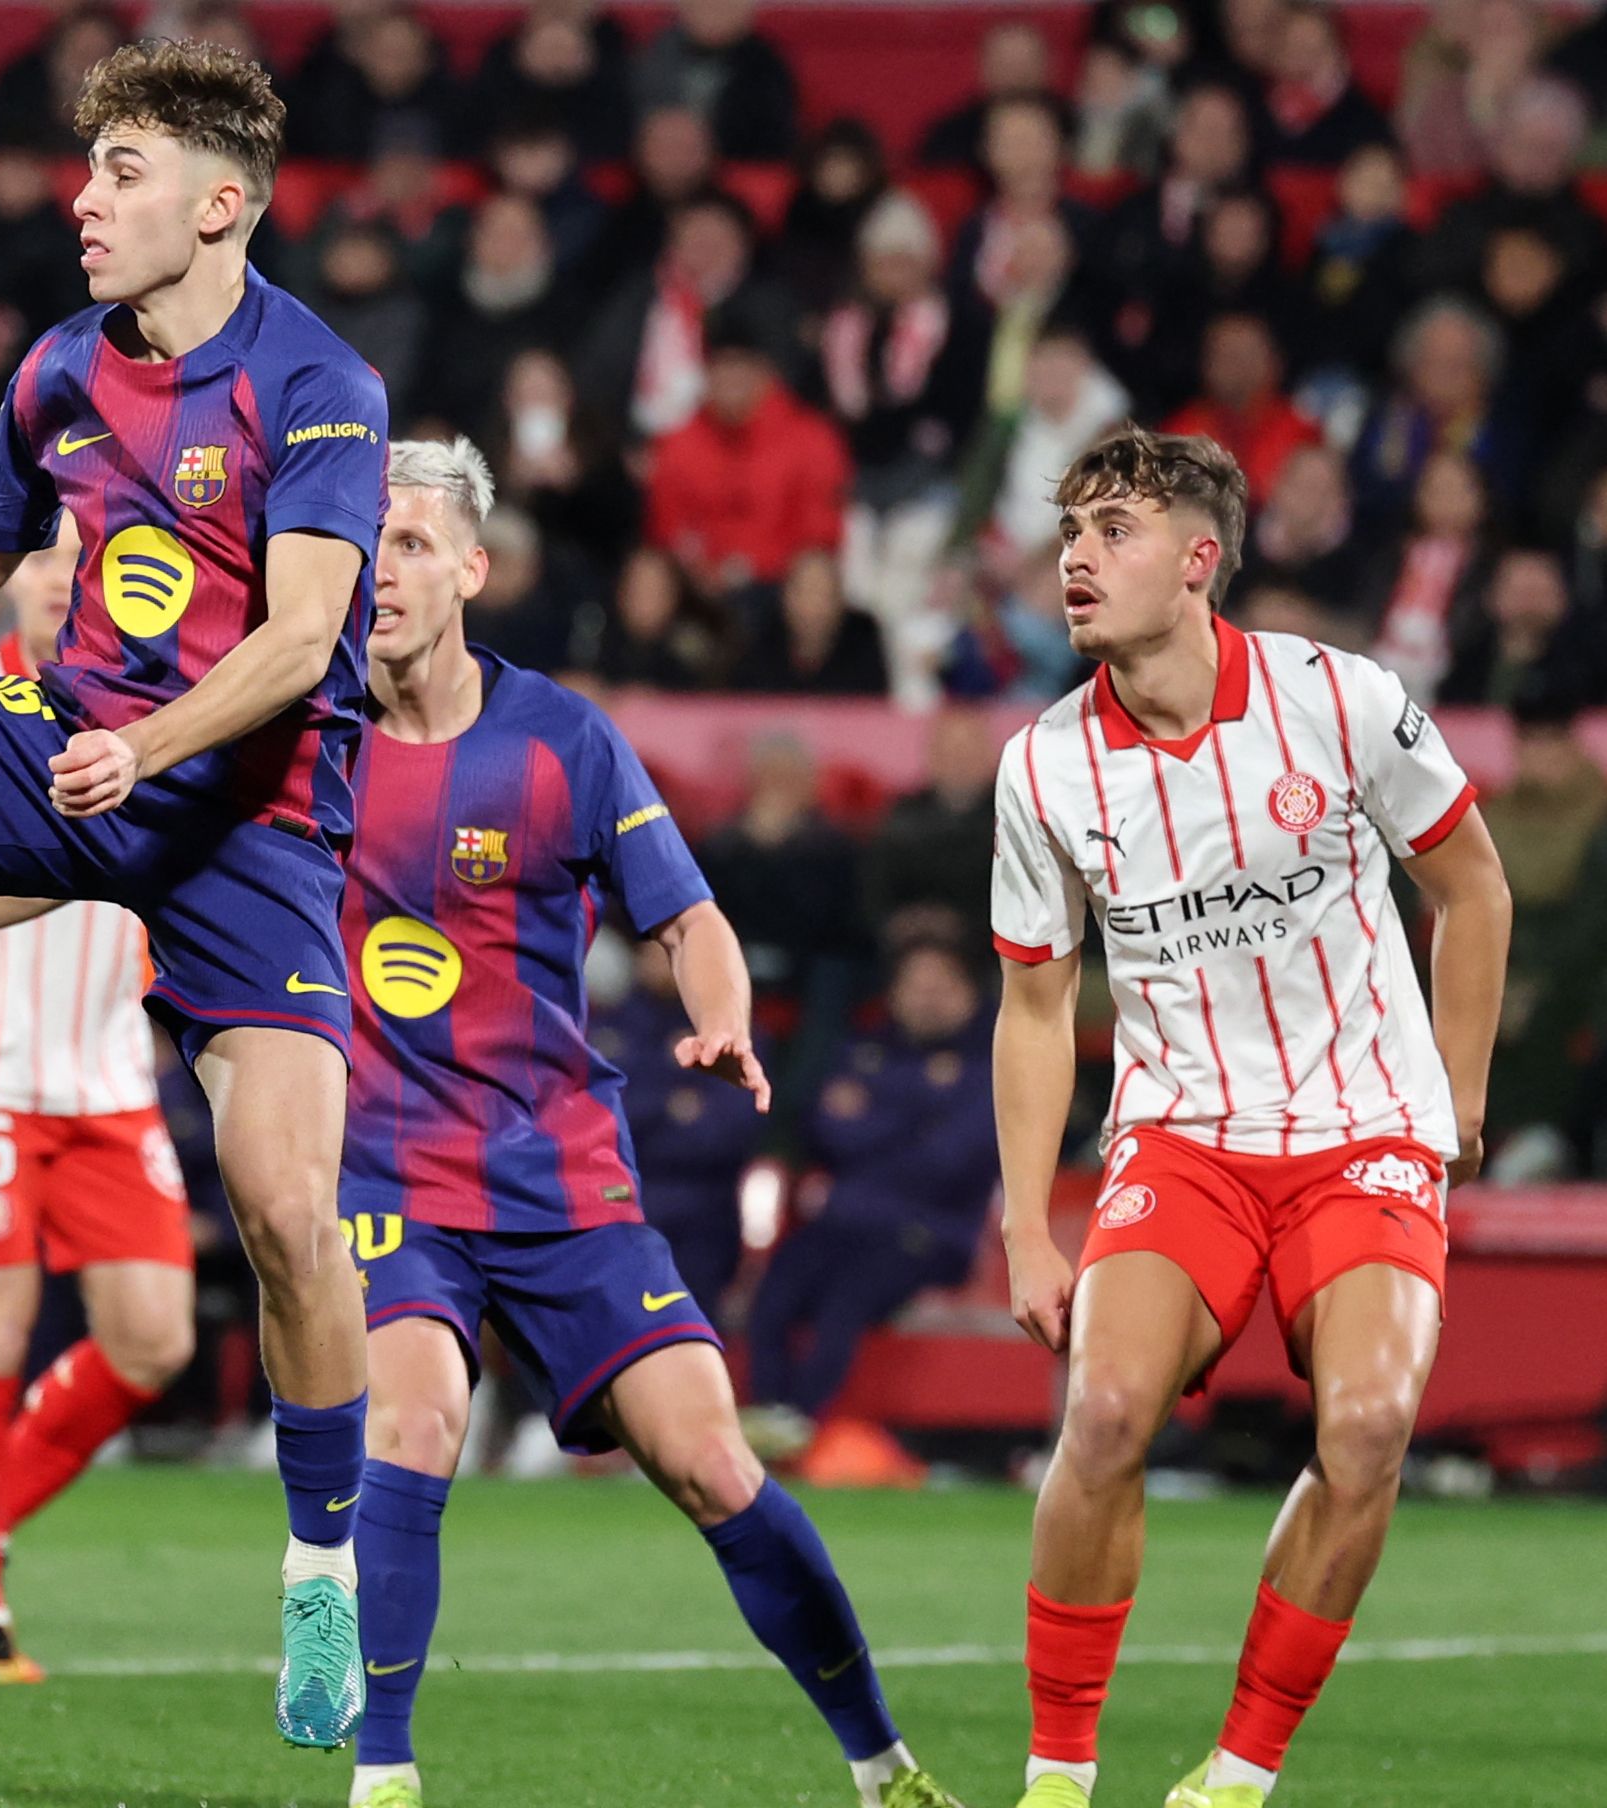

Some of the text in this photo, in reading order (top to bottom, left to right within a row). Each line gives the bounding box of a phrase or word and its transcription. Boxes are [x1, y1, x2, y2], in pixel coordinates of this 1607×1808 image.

[287, 422, 368, 447] AMBILIGHT
[1273, 775, 1314, 793] GIRONA
[1107, 866, 1325, 935] ETIHAD
[1159, 918, 1287, 966] AIRWAYS
